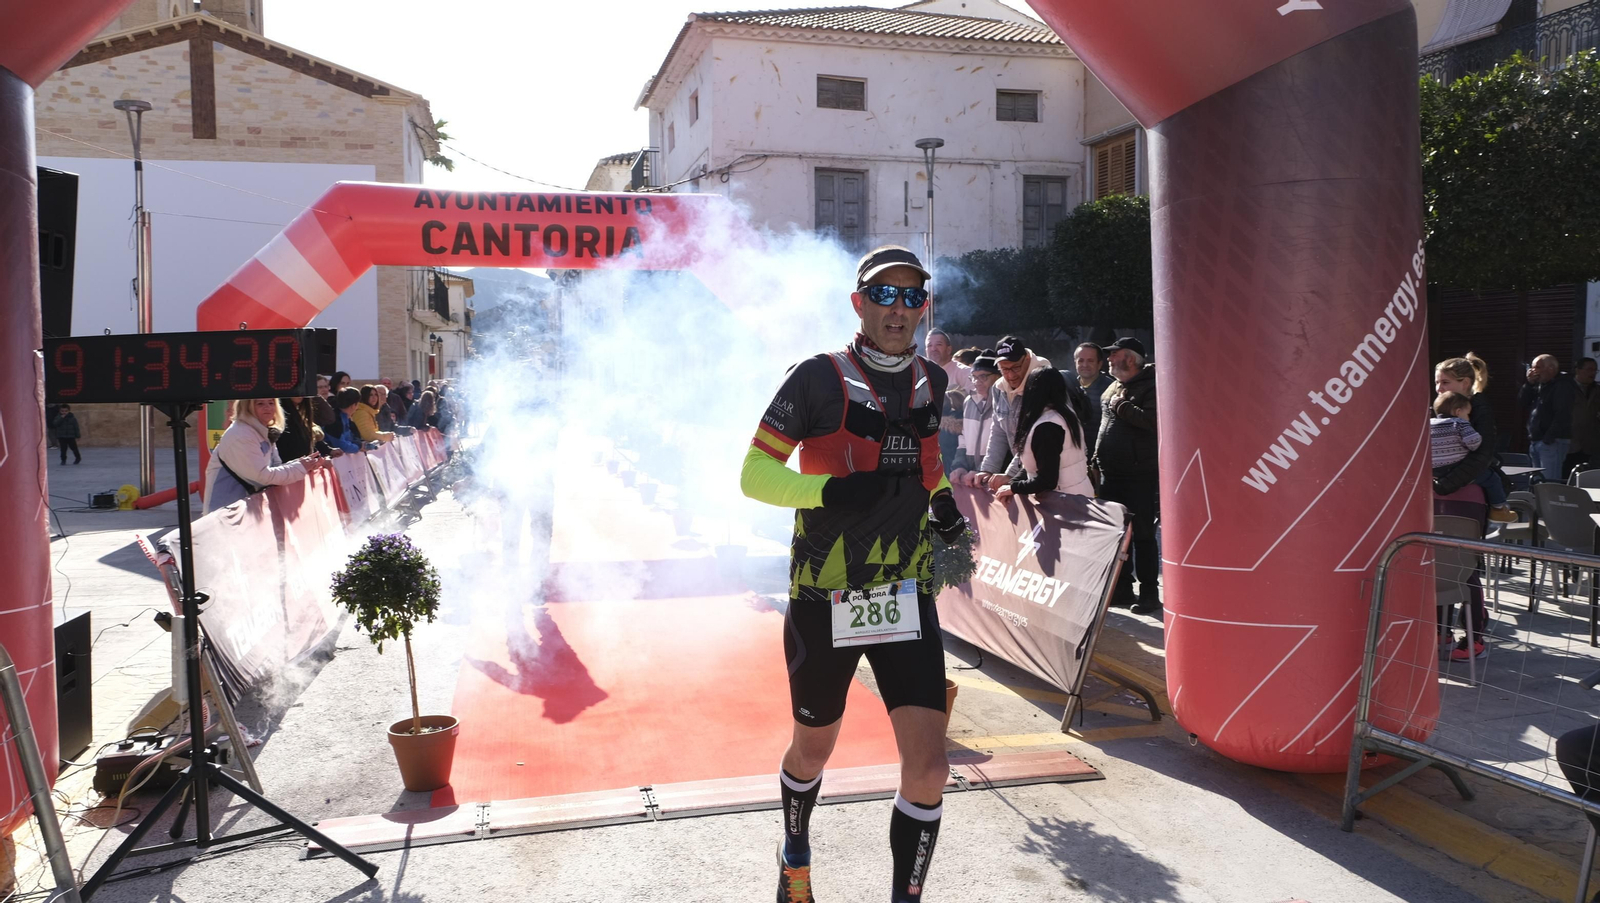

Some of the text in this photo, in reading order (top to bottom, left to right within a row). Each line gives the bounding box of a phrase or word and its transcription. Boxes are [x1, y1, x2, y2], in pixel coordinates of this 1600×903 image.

[414, 190, 653, 216] AYUNTAMIENTO
[421, 219, 645, 259] CANTORIA
[1241, 239, 1426, 494] www.teamergy.es
[882, 435, 919, 451] JELL
[974, 555, 1070, 608] TEAMERGY
[850, 600, 901, 628] 286
